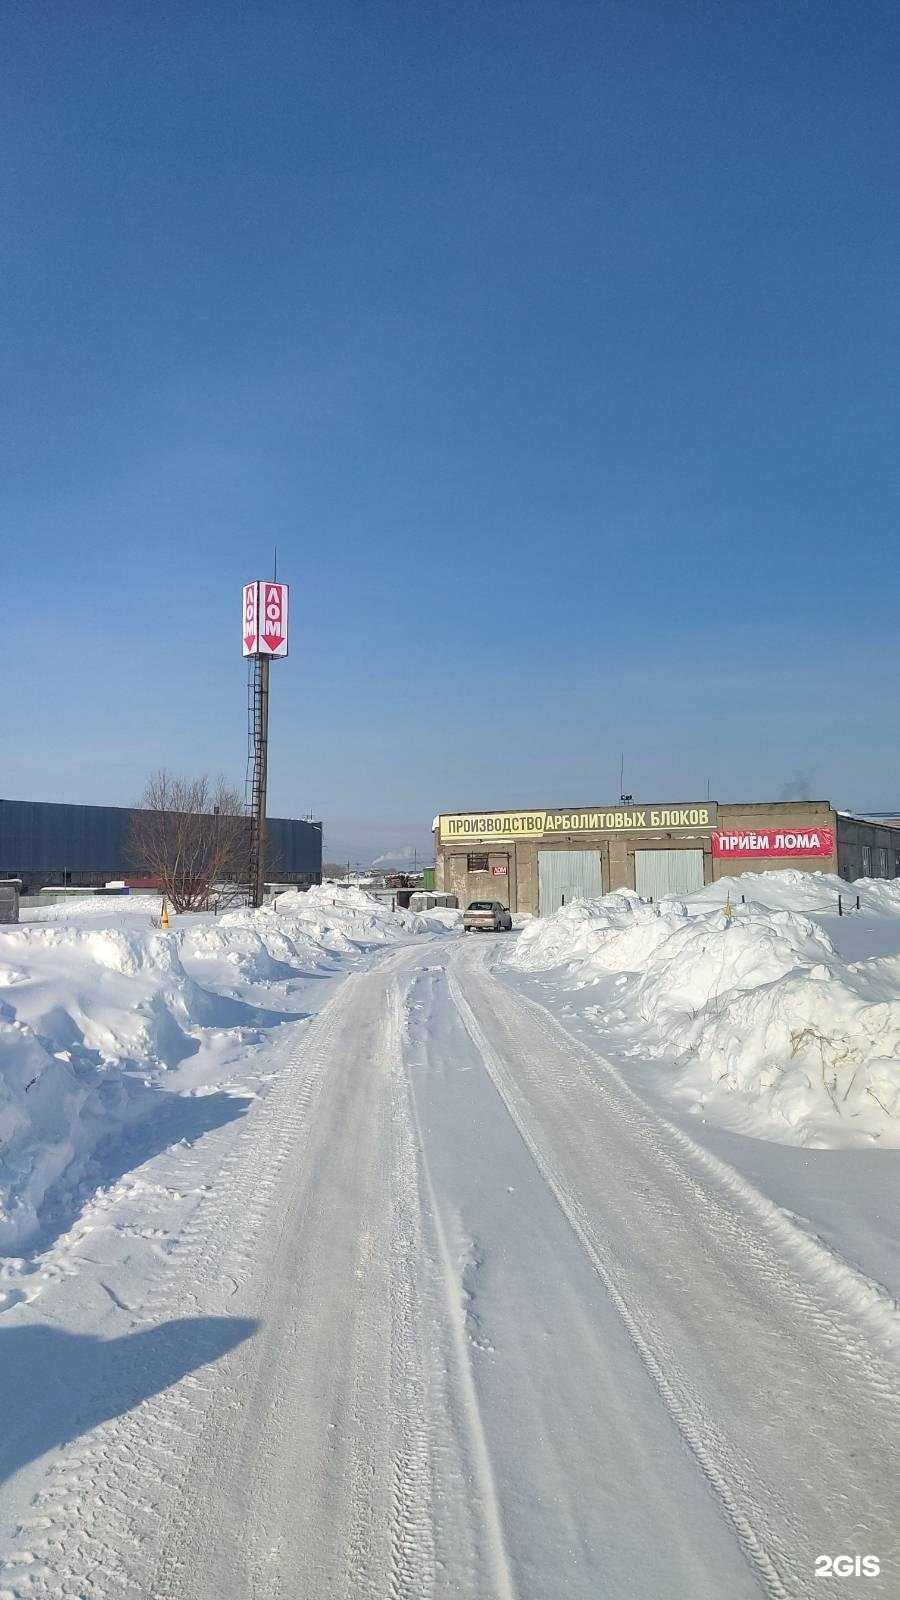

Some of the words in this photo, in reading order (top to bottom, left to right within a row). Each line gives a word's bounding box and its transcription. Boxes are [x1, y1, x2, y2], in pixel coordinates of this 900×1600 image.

[265, 588, 281, 636] ЛОМ
[448, 815, 543, 834] ПРОИЗВОДСТВО
[545, 811, 646, 830] АРБОЛИТОВЫХ
[650, 809, 709, 827] БЛОКОВ
[719, 832, 769, 851] ПРИЁМ
[774, 834, 821, 849] ЛОМА
